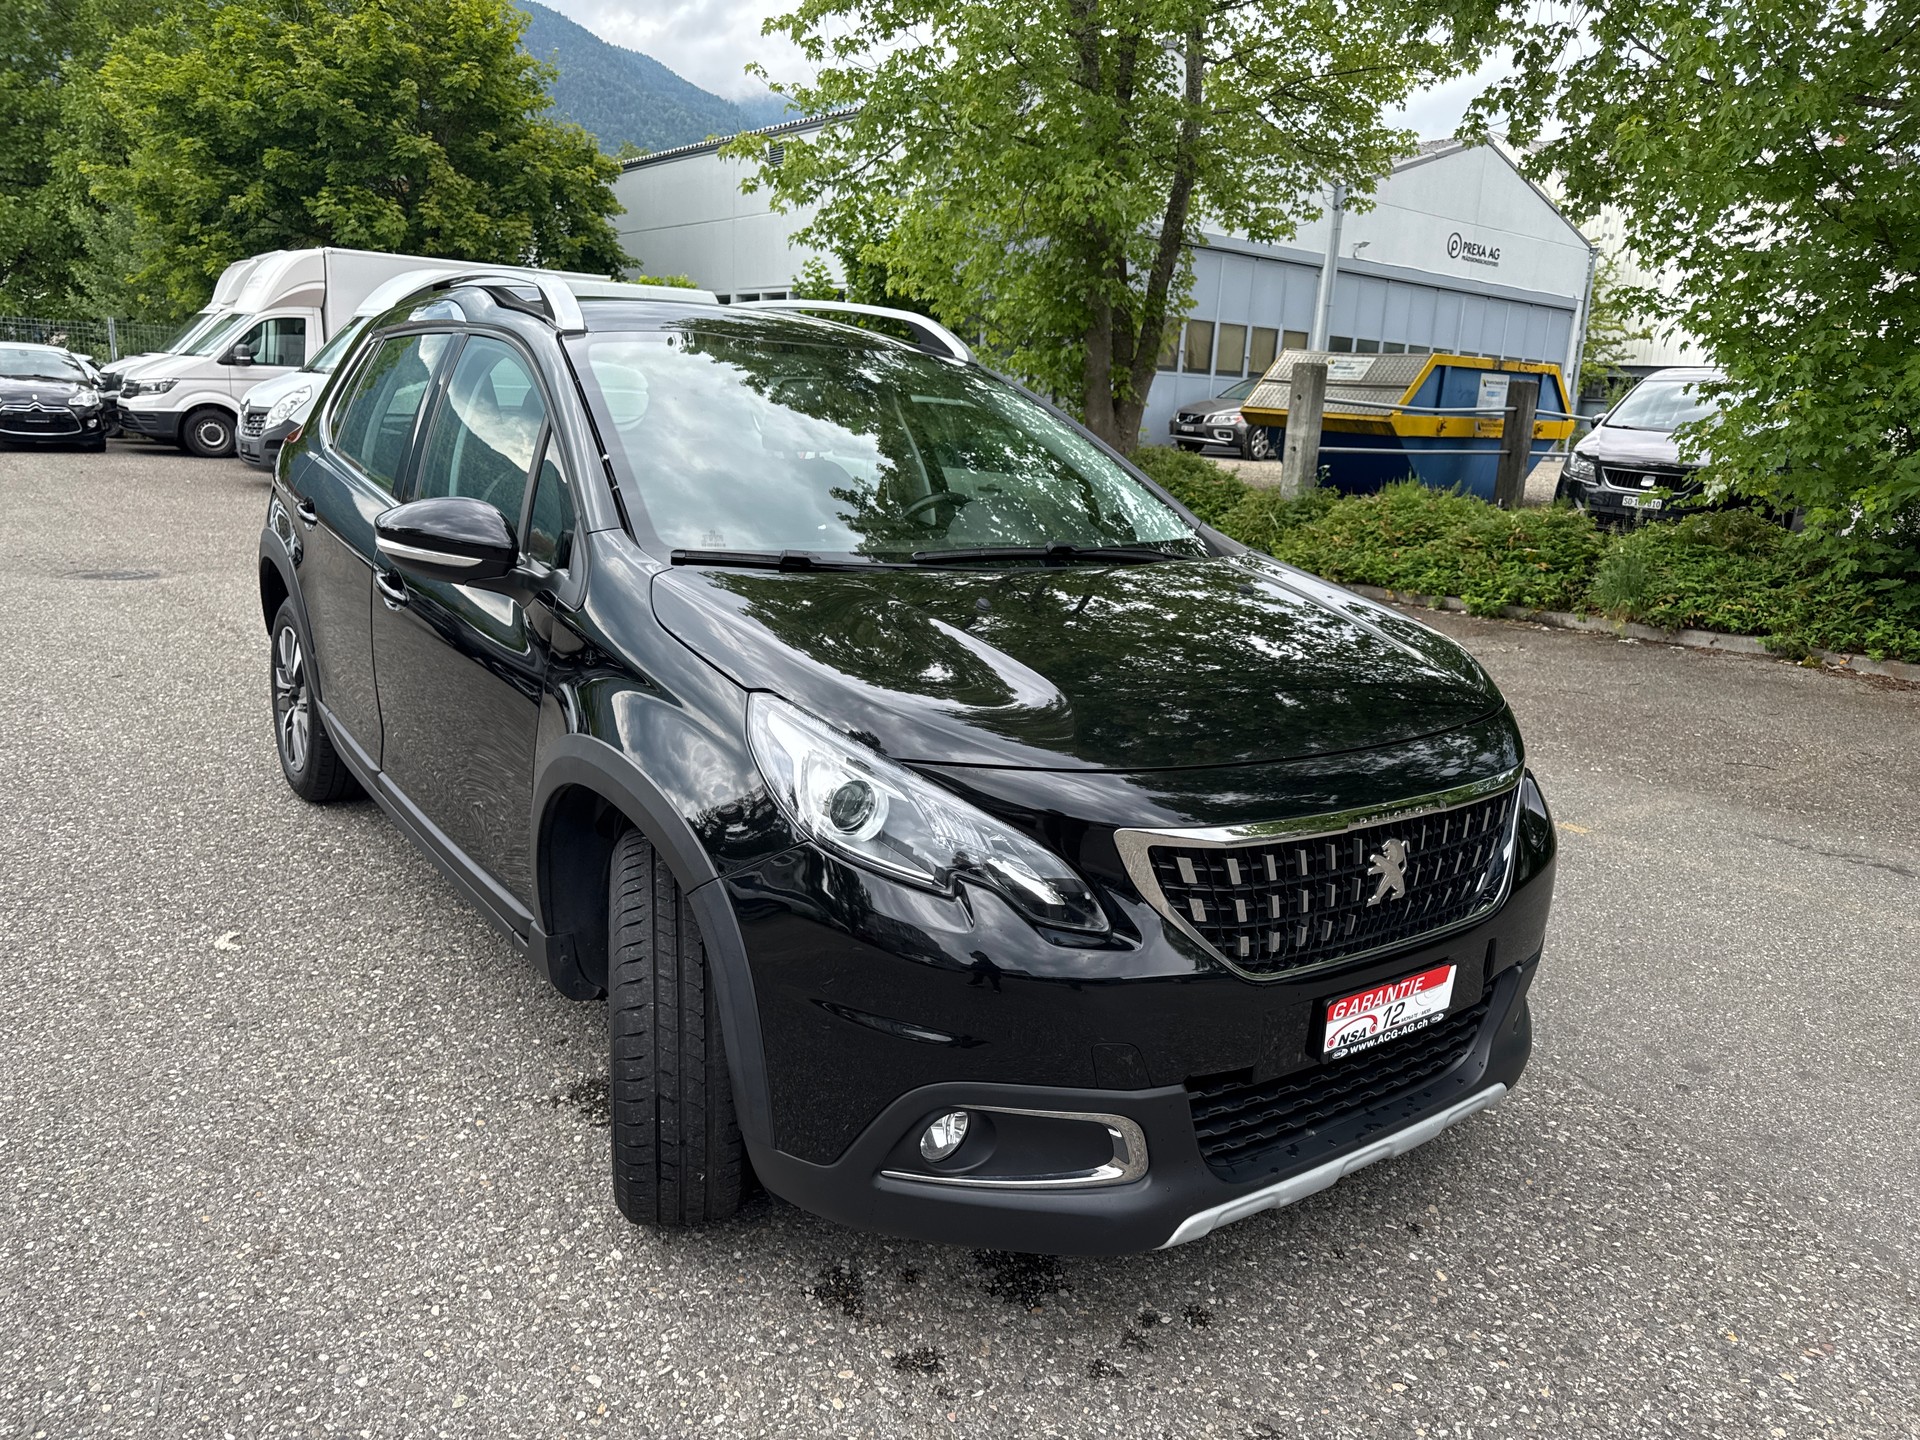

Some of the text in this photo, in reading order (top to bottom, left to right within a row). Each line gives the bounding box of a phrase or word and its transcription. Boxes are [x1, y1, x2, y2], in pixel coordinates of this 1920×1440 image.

[1463, 241, 1500, 260] PREXA AG
[1360, 803, 1433, 826] PEUGEOT
[1333, 976, 1425, 1019] GARANTIE
[1383, 1001, 1406, 1029] 12
[1338, 1027, 1367, 1046] NSA
[1350, 1018, 1428, 1054] www.ACG-AG.ch
